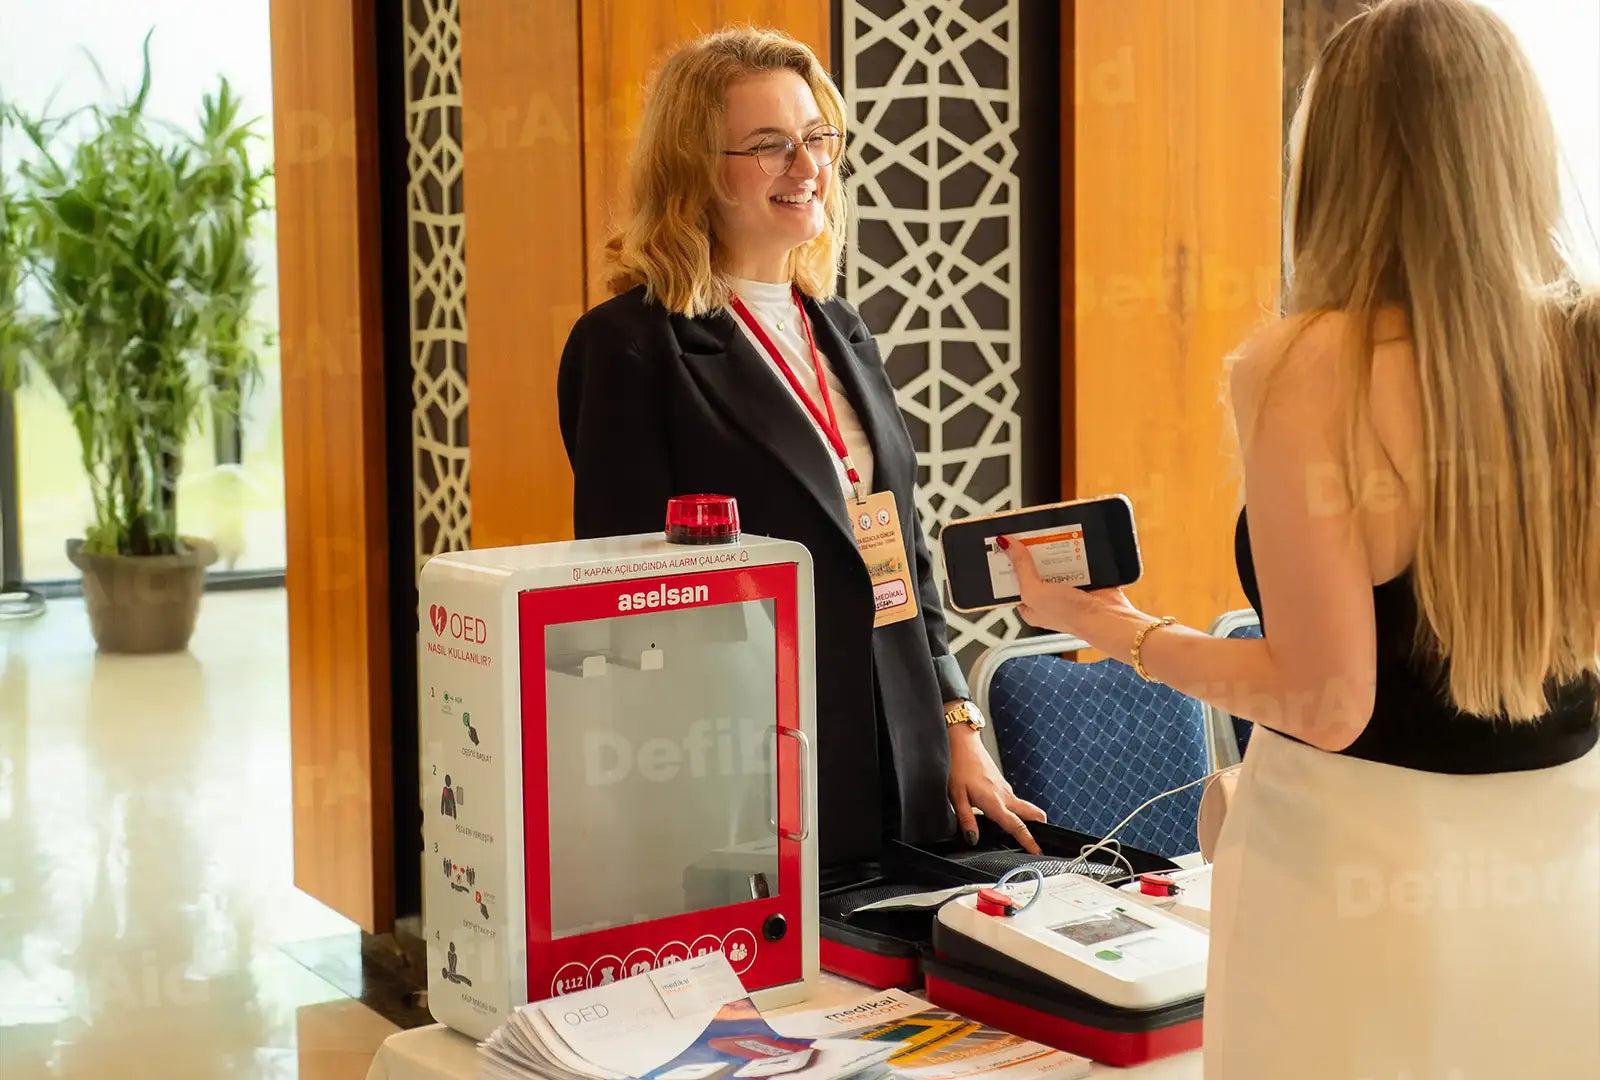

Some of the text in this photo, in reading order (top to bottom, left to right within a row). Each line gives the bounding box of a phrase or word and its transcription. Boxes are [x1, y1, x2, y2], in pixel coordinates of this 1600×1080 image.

[584, 554, 737, 577] KAPAK AÇILDIĞINDA ALARM ÇALACAK
[618, 584, 709, 611] aselsan
[450, 612, 487, 644] OED
[427, 642, 492, 667] NASIL KULLANILIR?
[430, 687, 436, 698] 1
[432, 764, 437, 776] 2
[433, 841, 439, 854] 3
[434, 930, 440, 941] 4
[565, 976, 583, 990] 112
[564, 1004, 609, 1026] OED
[824, 996, 898, 1020] medikal
